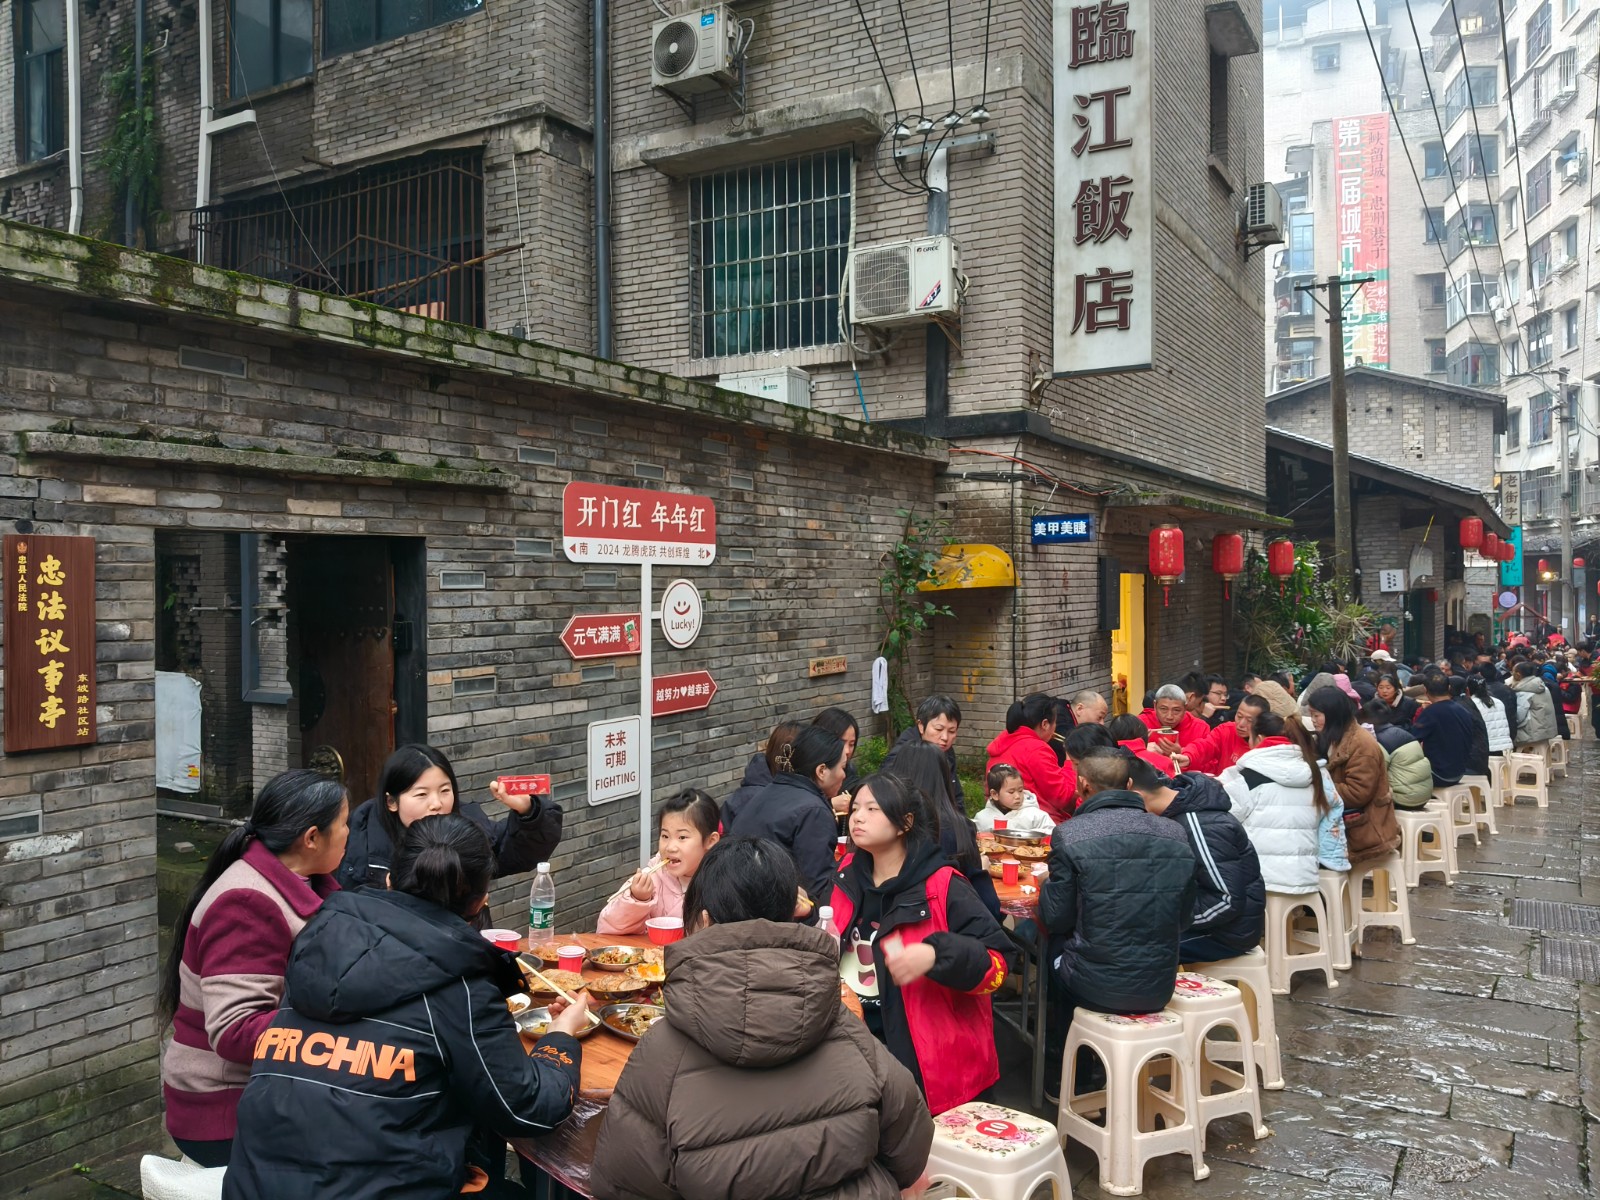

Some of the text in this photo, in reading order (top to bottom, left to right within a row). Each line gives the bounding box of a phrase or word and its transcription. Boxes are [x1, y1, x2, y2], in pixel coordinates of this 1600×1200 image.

[1068, 1, 1134, 335] 臨江飯店
[1504, 474, 1518, 525] 老街字
[577, 496, 706, 533] 开门红 年年红
[1034, 521, 1087, 536] 美甲美睫
[579, 543, 706, 559] 南 2024 龙腾虎跃 共创辉煌 北
[17, 555, 28, 612] 忠县人民法院
[671, 618, 695, 631] Lucky!
[35, 554, 70, 729] 忠法议事亭
[573, 625, 621, 646] 元气满满
[656, 683, 710, 702] 越努力 越幸运
[76, 673, 90, 736] 东坡路社区站
[604, 730, 626, 748] 未来
[605, 750, 627, 769] 可期
[595, 771, 636, 791] FIGHTING
